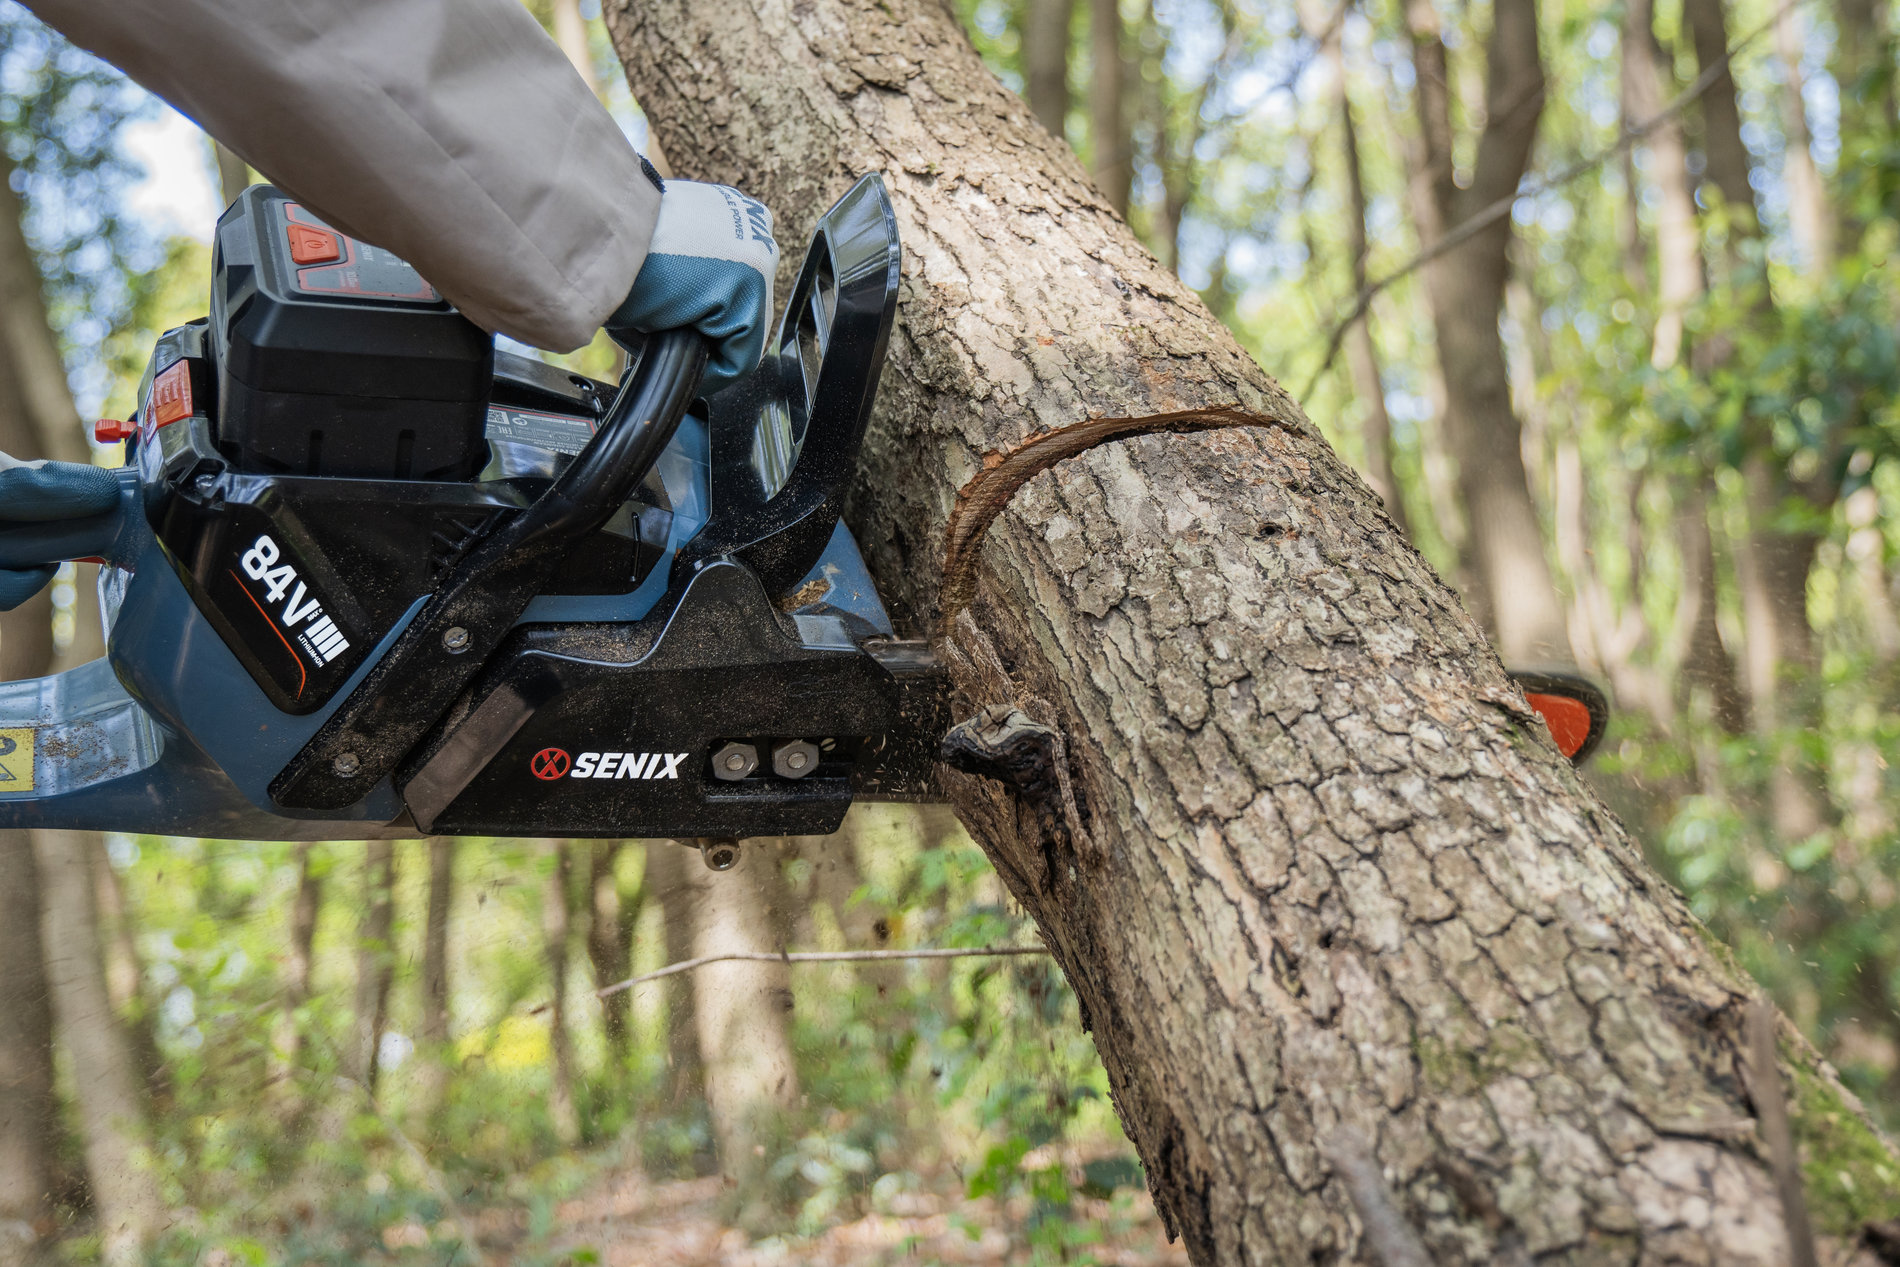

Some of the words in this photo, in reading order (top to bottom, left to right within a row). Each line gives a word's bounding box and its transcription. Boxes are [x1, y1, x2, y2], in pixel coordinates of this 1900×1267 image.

[730, 208, 744, 240] POWER
[241, 534, 321, 627] 84V
[297, 634, 325, 668] LITHIUM-ION
[571, 752, 689, 779] SENIX
